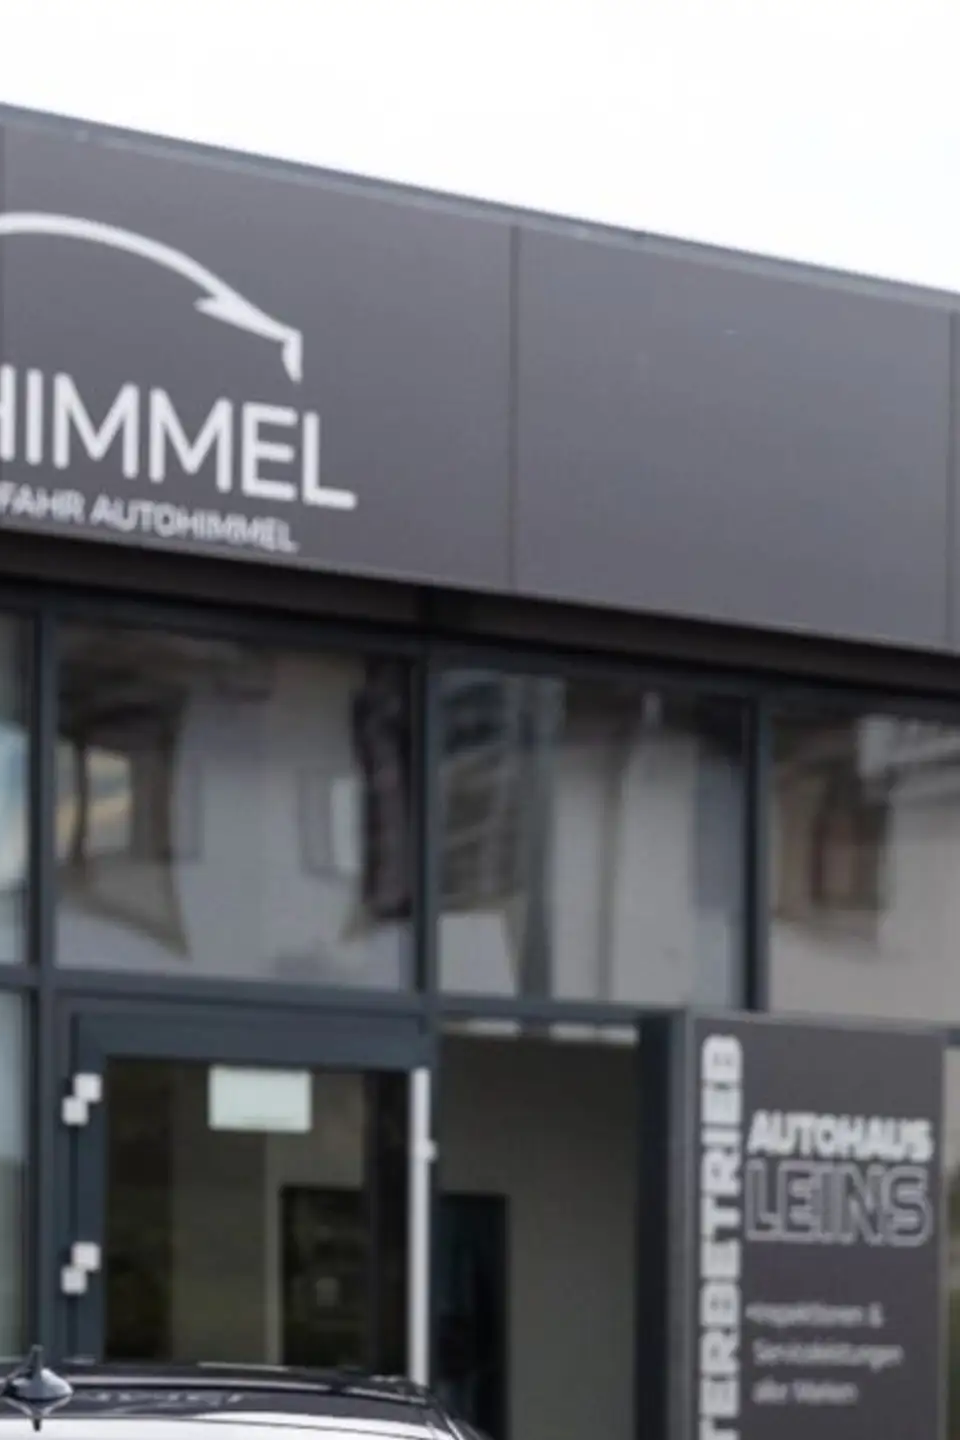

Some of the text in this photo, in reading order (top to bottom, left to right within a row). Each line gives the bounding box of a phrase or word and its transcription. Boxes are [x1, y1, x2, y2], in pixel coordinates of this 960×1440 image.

[90, 493, 300, 554] AUTOHIMMEL
[746, 1109, 934, 1163] AUTOHAUS
[744, 1158, 933, 1248] LEINS
